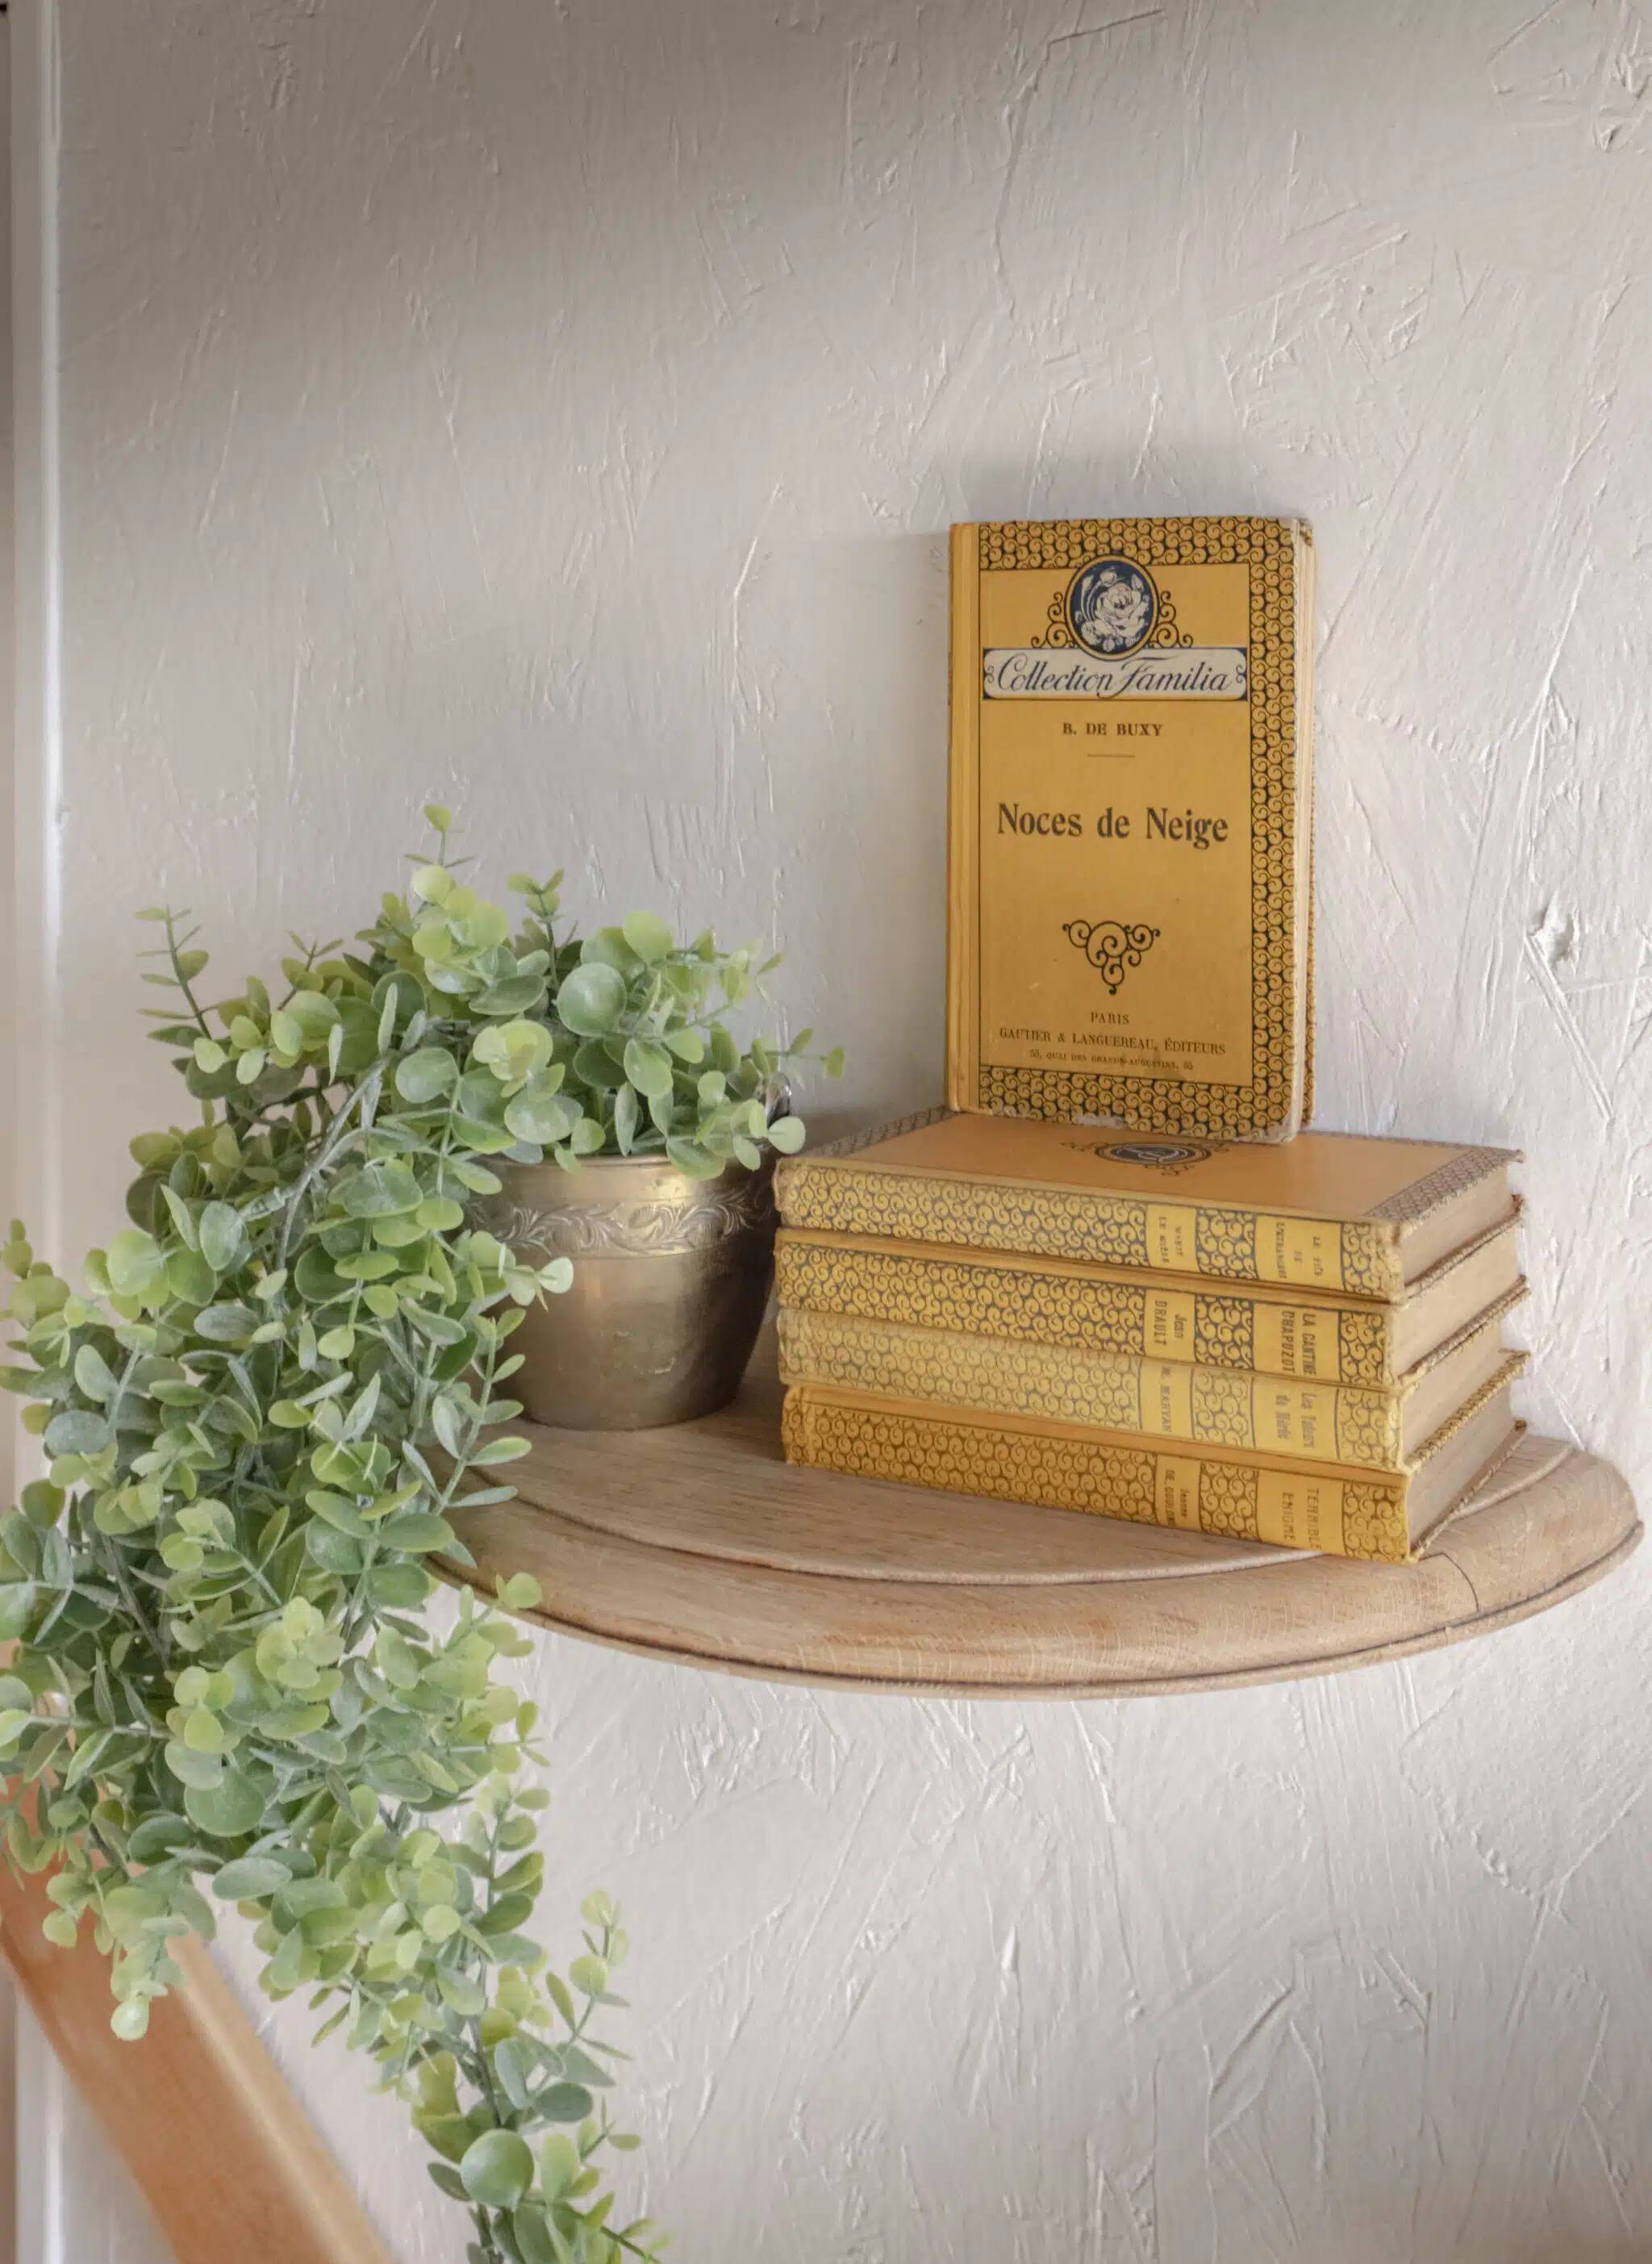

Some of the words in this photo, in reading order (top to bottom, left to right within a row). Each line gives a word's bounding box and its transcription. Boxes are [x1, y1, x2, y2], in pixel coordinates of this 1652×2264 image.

[997, 652, 1113, 692] Collection
[1097, 656, 1233, 700] Familia
[1086, 722, 1108, 737] DE
[1116, 723, 1164, 737] BUXY
[997, 803, 1083, 837] Noces
[1096, 807, 1130, 838] de
[1145, 807, 1229, 850] Neige
[1091, 1012, 1129, 1025] PARIS
[999, 1026, 1051, 1042] GAUTIER
[1058, 1032, 1066, 1043] &
[1072, 1032, 1158, 1051] LANGUEREAU,
[1164, 1037, 1226, 1055] ÉDITEURS
[1046, 1051, 1067, 1060] QUAI
[1153, 1300, 1168, 1346] DRAULT
[1174, 1313, 1188, 1339] Jean
[1302, 1313, 1316, 1326] LA
[1306, 1487, 1323, 1550] TERRIBLE
